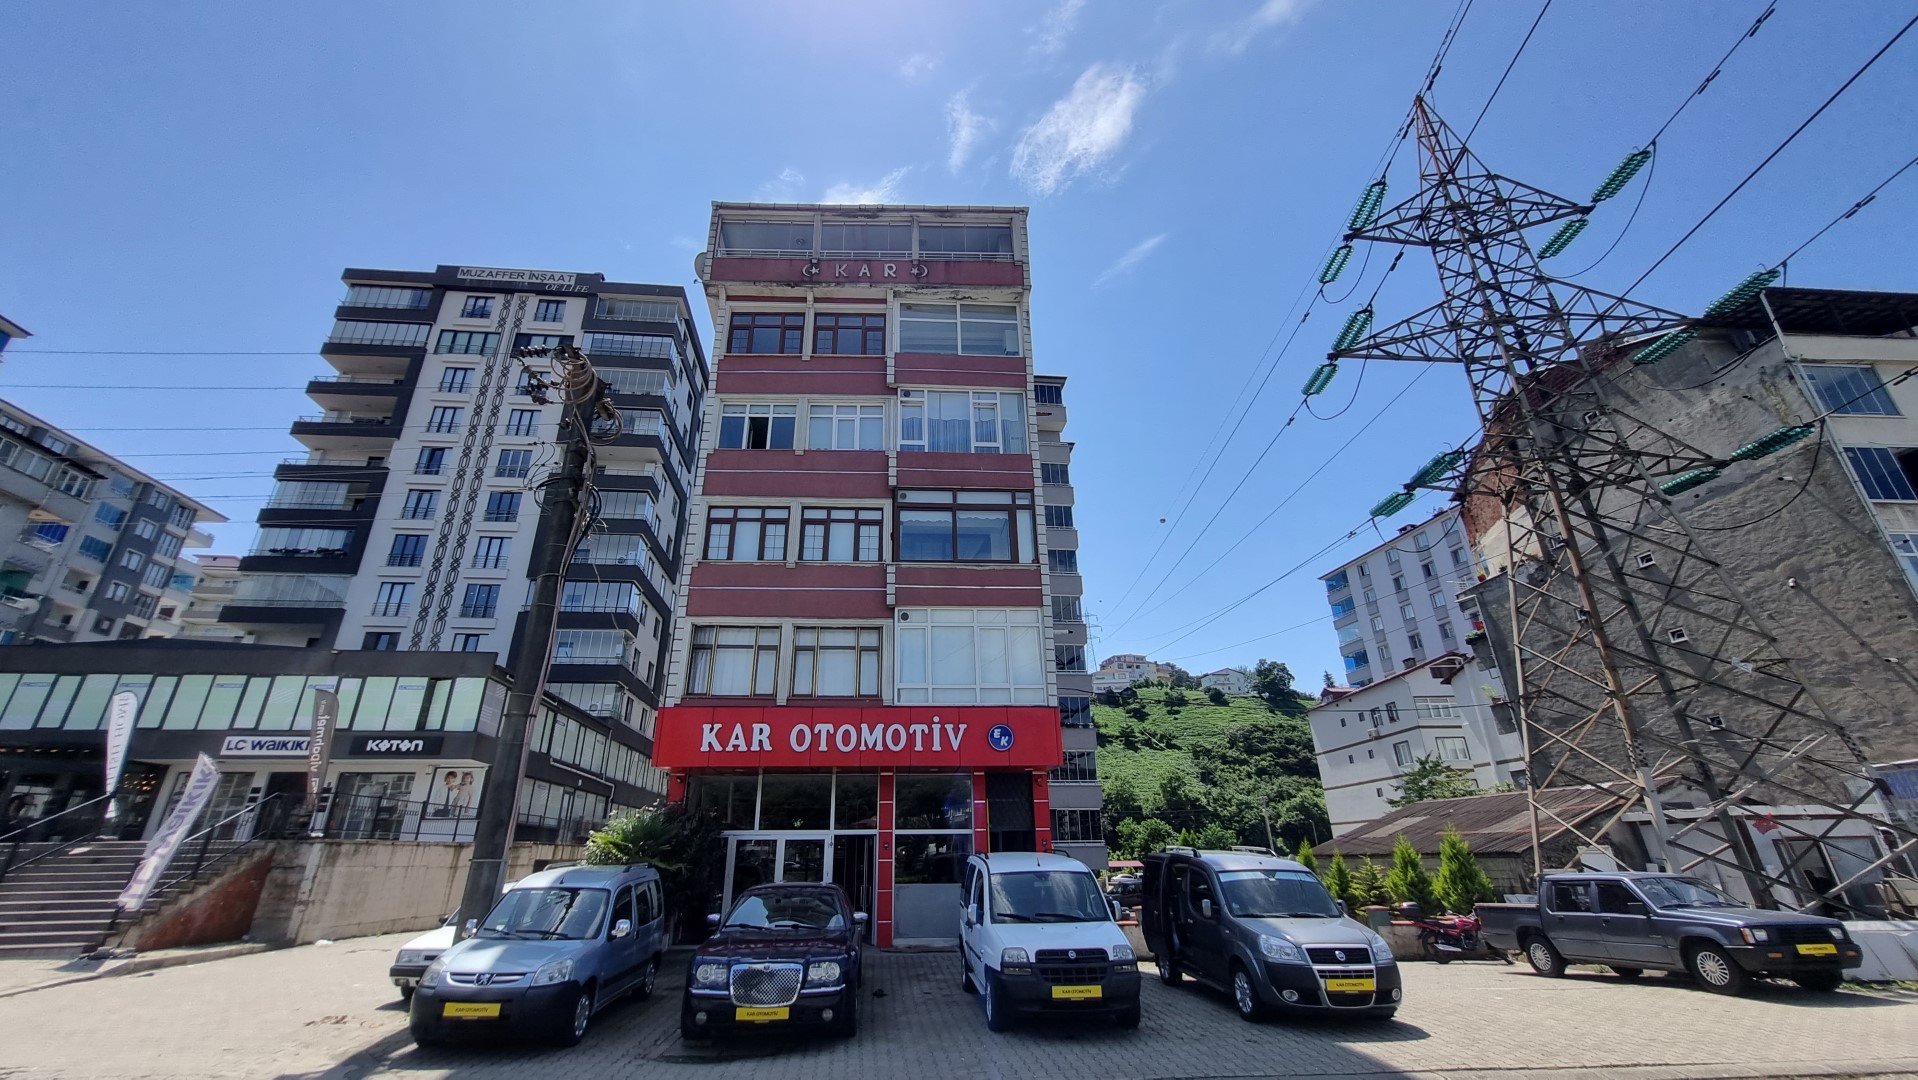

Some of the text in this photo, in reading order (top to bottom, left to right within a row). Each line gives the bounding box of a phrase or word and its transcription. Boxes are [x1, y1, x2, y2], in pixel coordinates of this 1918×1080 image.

[459, 268, 575, 284] MUZAFFER İNŞAAT
[835, 263, 897, 277] KAR
[545, 283, 560, 291] OF
[700, 715, 967, 752] KAR OTOMOTİV
[993, 728, 1009, 746] EK
[225, 739, 247, 751] LC
